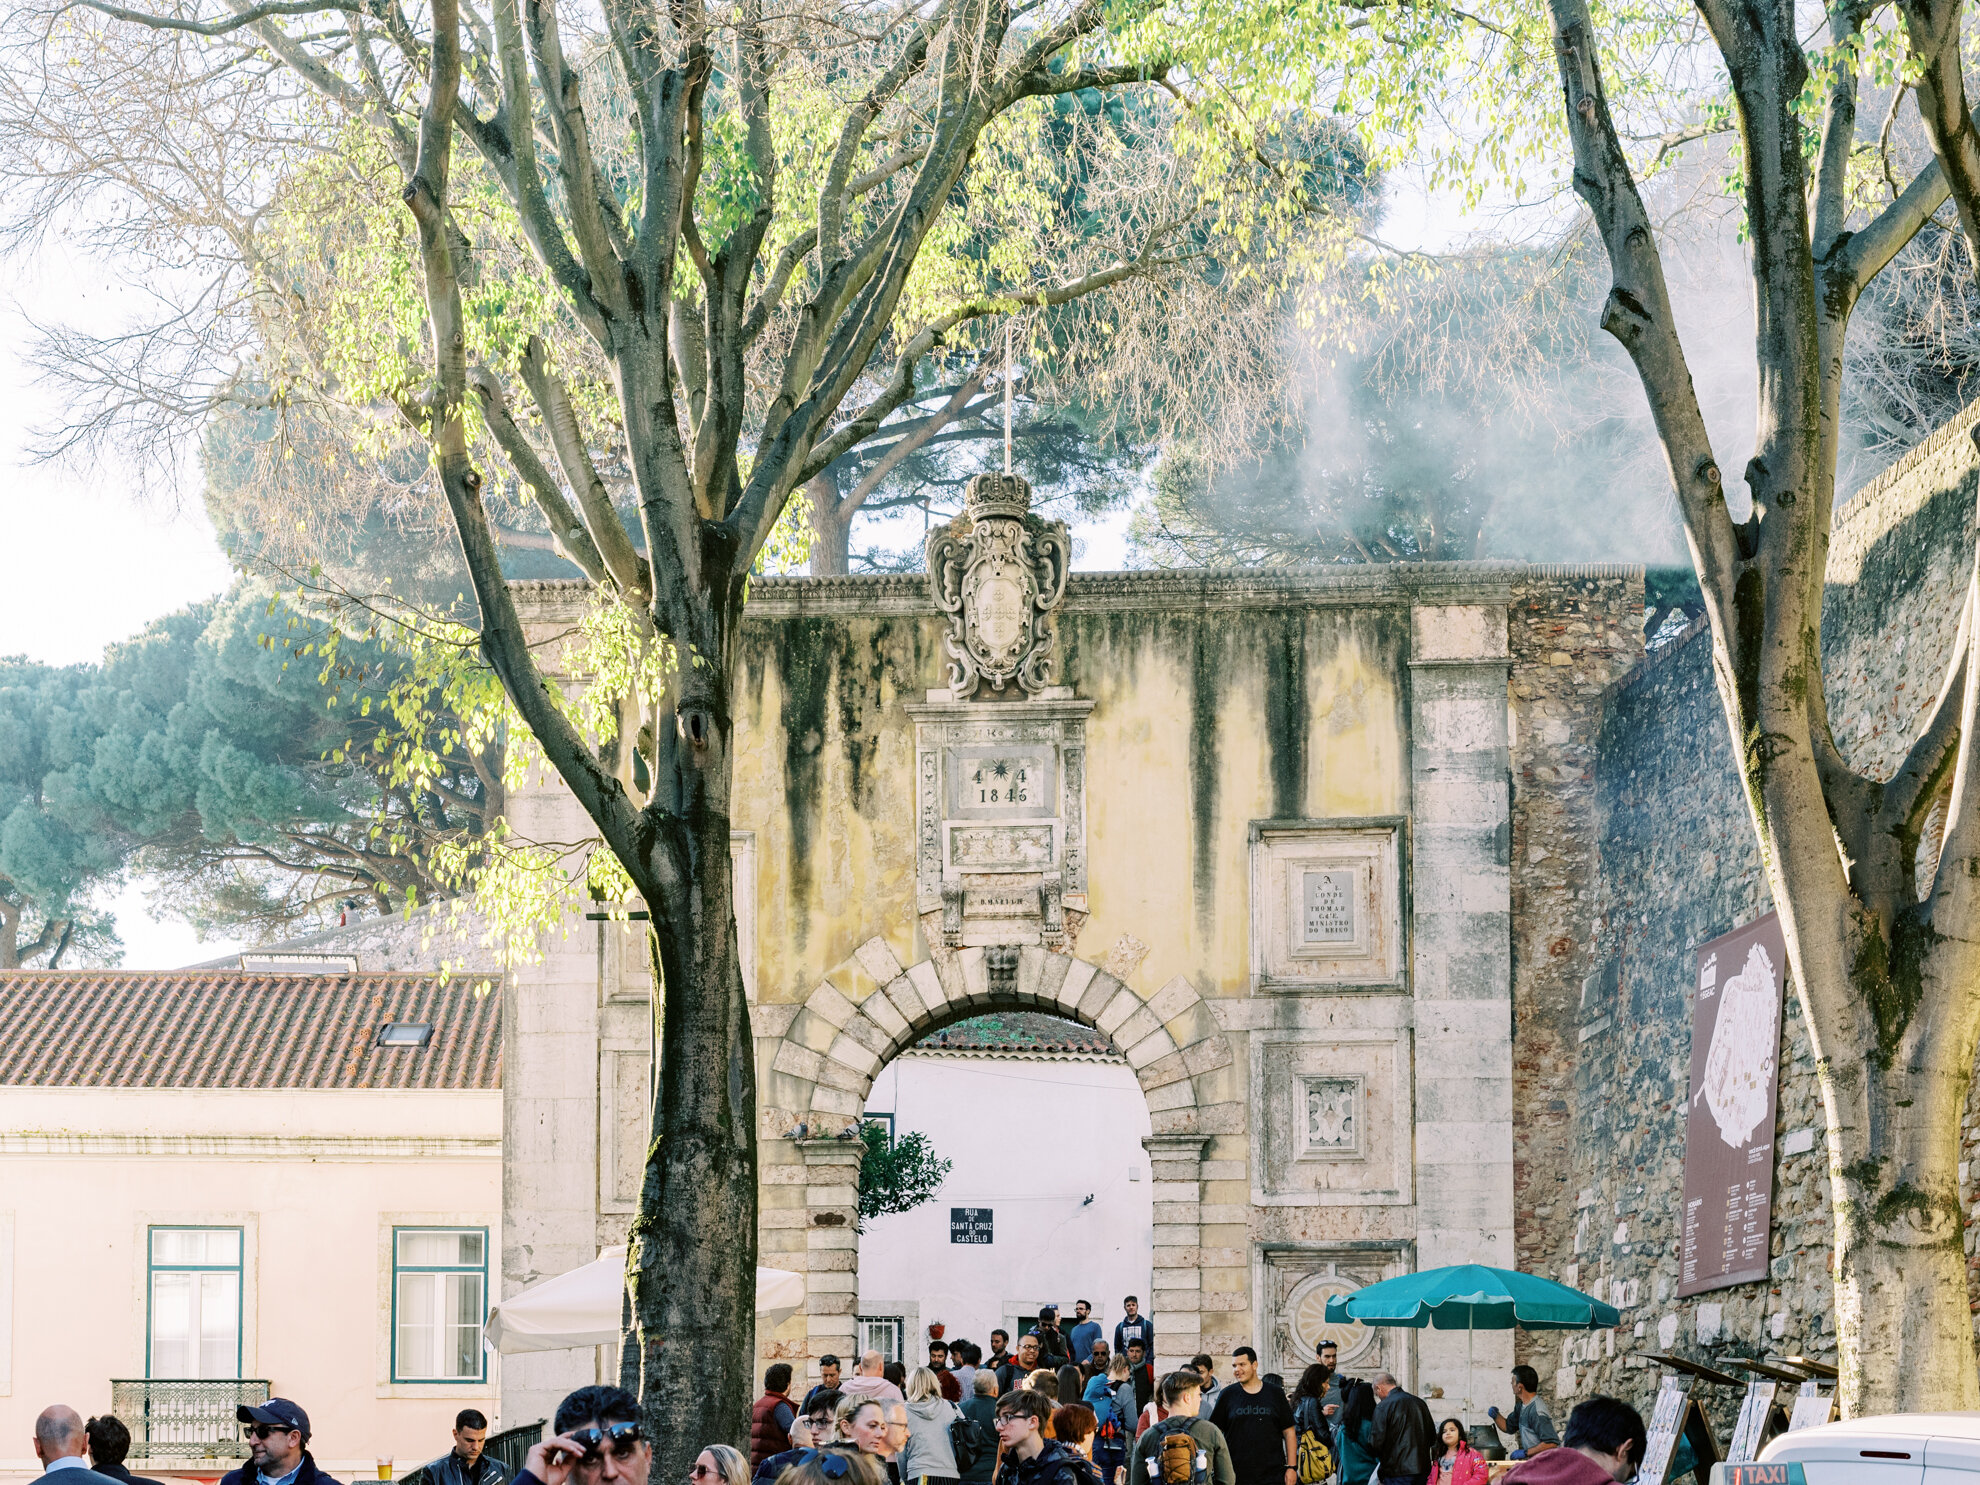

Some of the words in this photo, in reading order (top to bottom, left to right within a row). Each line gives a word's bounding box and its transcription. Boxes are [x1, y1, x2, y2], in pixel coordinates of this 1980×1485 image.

[972, 770, 984, 784] 4
[1016, 768, 1027, 783] 4
[980, 788, 1028, 803] 1846
[951, 1222, 973, 1230] SANTA
[974, 1222, 993, 1230] CRUZ
[956, 1235, 988, 1243] CASTELO
[1235, 1404, 1271, 1415] adidas
[1744, 1465, 1786, 1484] TAXI
